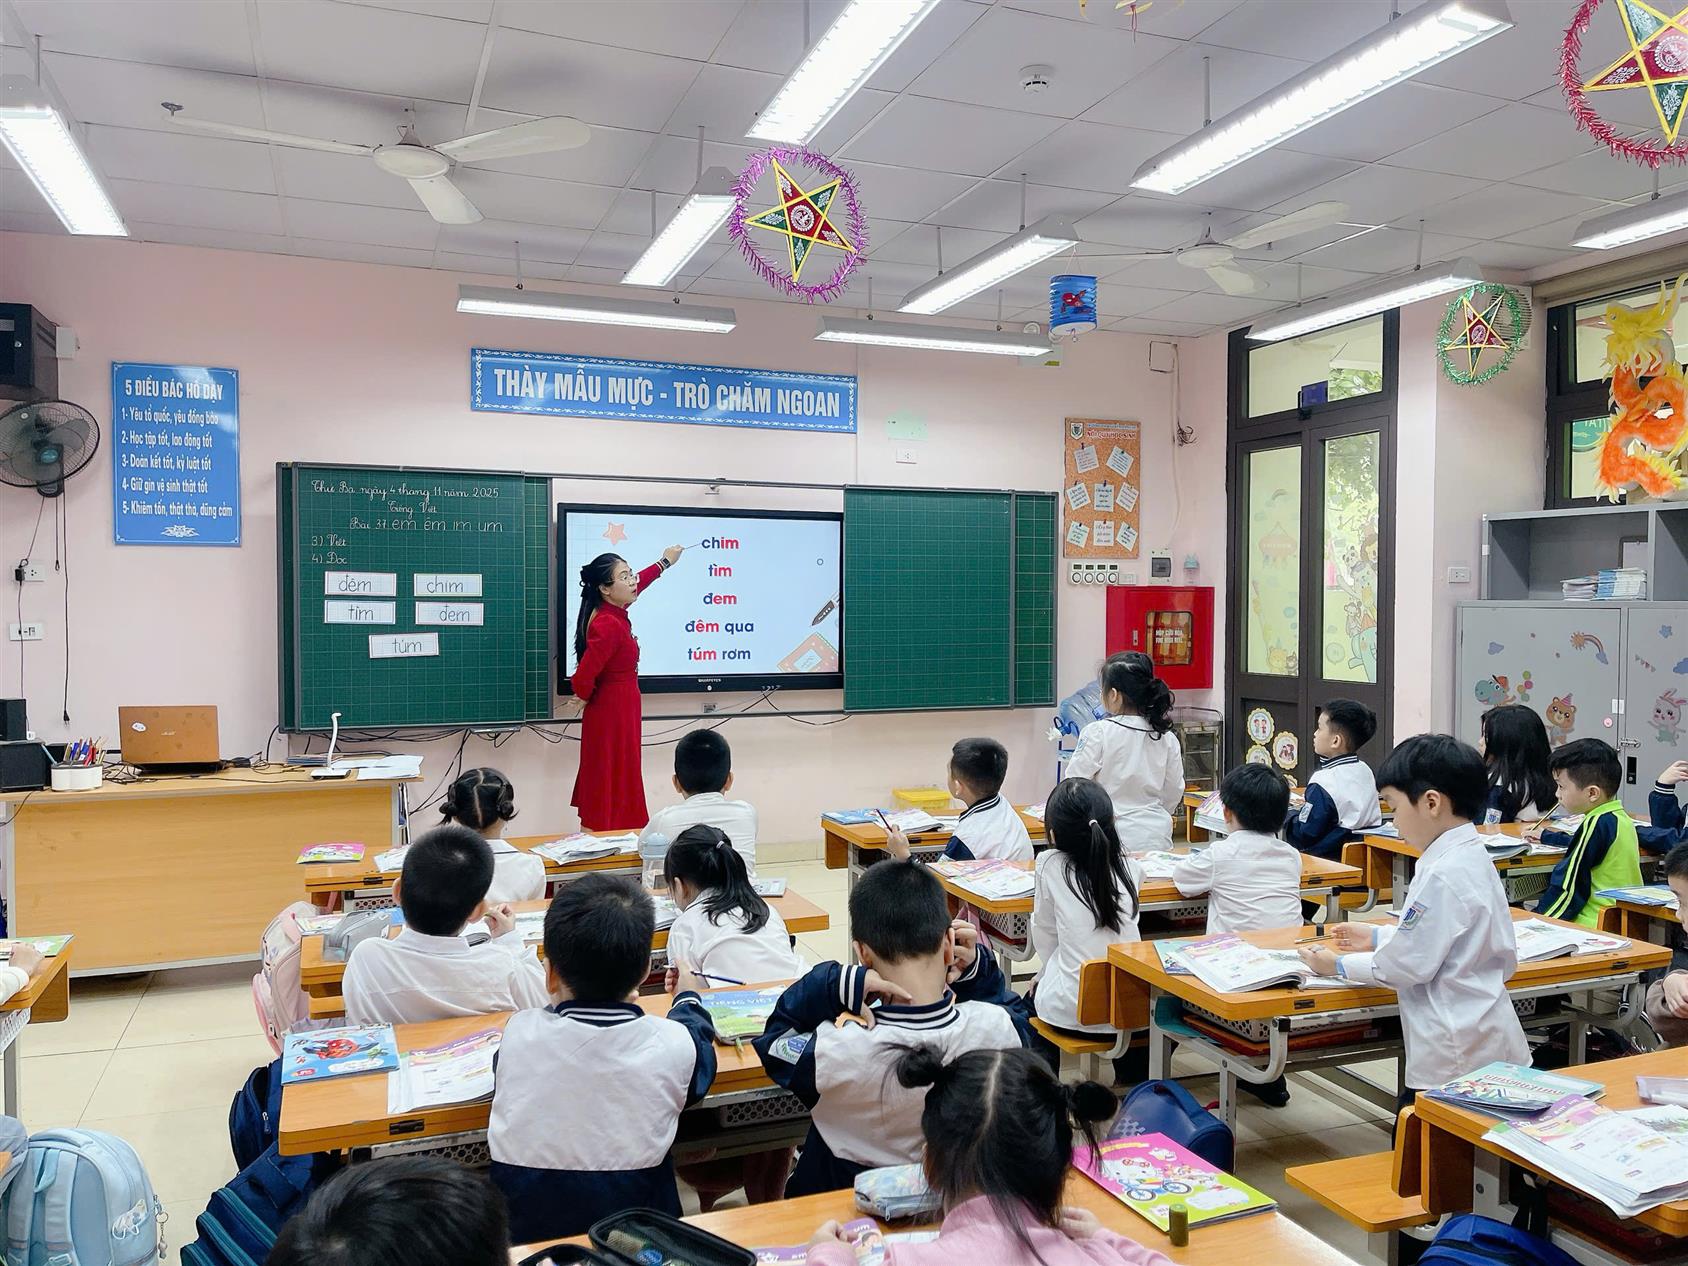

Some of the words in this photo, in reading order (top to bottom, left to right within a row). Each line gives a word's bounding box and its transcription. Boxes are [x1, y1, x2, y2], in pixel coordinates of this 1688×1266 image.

[125, 379, 132, 396] 5
[135, 375, 159, 397] ĐIỀU
[162, 378, 183, 398] BÁC
[203, 384, 223, 403] DẠY
[555, 363, 601, 402] MẪU
[608, 377, 653, 410] MỰC
[673, 377, 710, 409] TRÒ
[716, 381, 771, 413] CHĂM
[777, 389, 840, 418] NGOAN
[129, 407, 143, 421] Yêu
[174, 409, 186, 425] yêu
[130, 430, 143, 448] Học
[145, 431, 157, 448] tập
[171, 432, 182, 446] lao
[184, 432, 201, 450] động
[202, 431, 212, 448] tốt
[150, 452, 161, 468] kết
[187, 456, 200, 474] luật
[201, 454, 211, 470] tốt
[130, 476, 143, 491] Giữ
[156, 478, 165, 496] vệ
[166, 478, 180, 492] sinh
[182, 479, 196, 496] thật
[198, 477, 208, 493] tốt
[311, 480, 335, 493] Thứ
[339, 481, 355, 493] Ba
[360, 485, 387, 501] ngày
[390, 484, 396, 495] 4
[434, 486, 441, 496] 11
[444, 488, 469, 497] năm
[473, 487, 499, 498] 2025
[131, 500, 152, 515] Khiêm
[169, 501, 184, 519] thật
[200, 502, 217, 519] dũng
[218, 501, 233, 517] cảm
[349, 517, 370, 529] Bài
[391, 519, 416, 530] em
[424, 517, 446, 531] êm
[453, 520, 472, 532] im
[478, 521, 503, 533] um
[311, 535, 324, 547] 3)
[701, 536, 739, 549] chim
[311, 553, 323, 564] 4)
[708, 563, 732, 577] tìm
[338, 574, 372, 592] đêm
[426, 575, 463, 593] chim
[703, 592, 737, 605] đem
[439, 603, 470, 622] đem
[685, 619, 719, 633] đêm
[725, 622, 754, 635] qua
[392, 637, 422, 653] túm
[688, 646, 717, 660] túm
[722, 648, 751, 660] rơm
